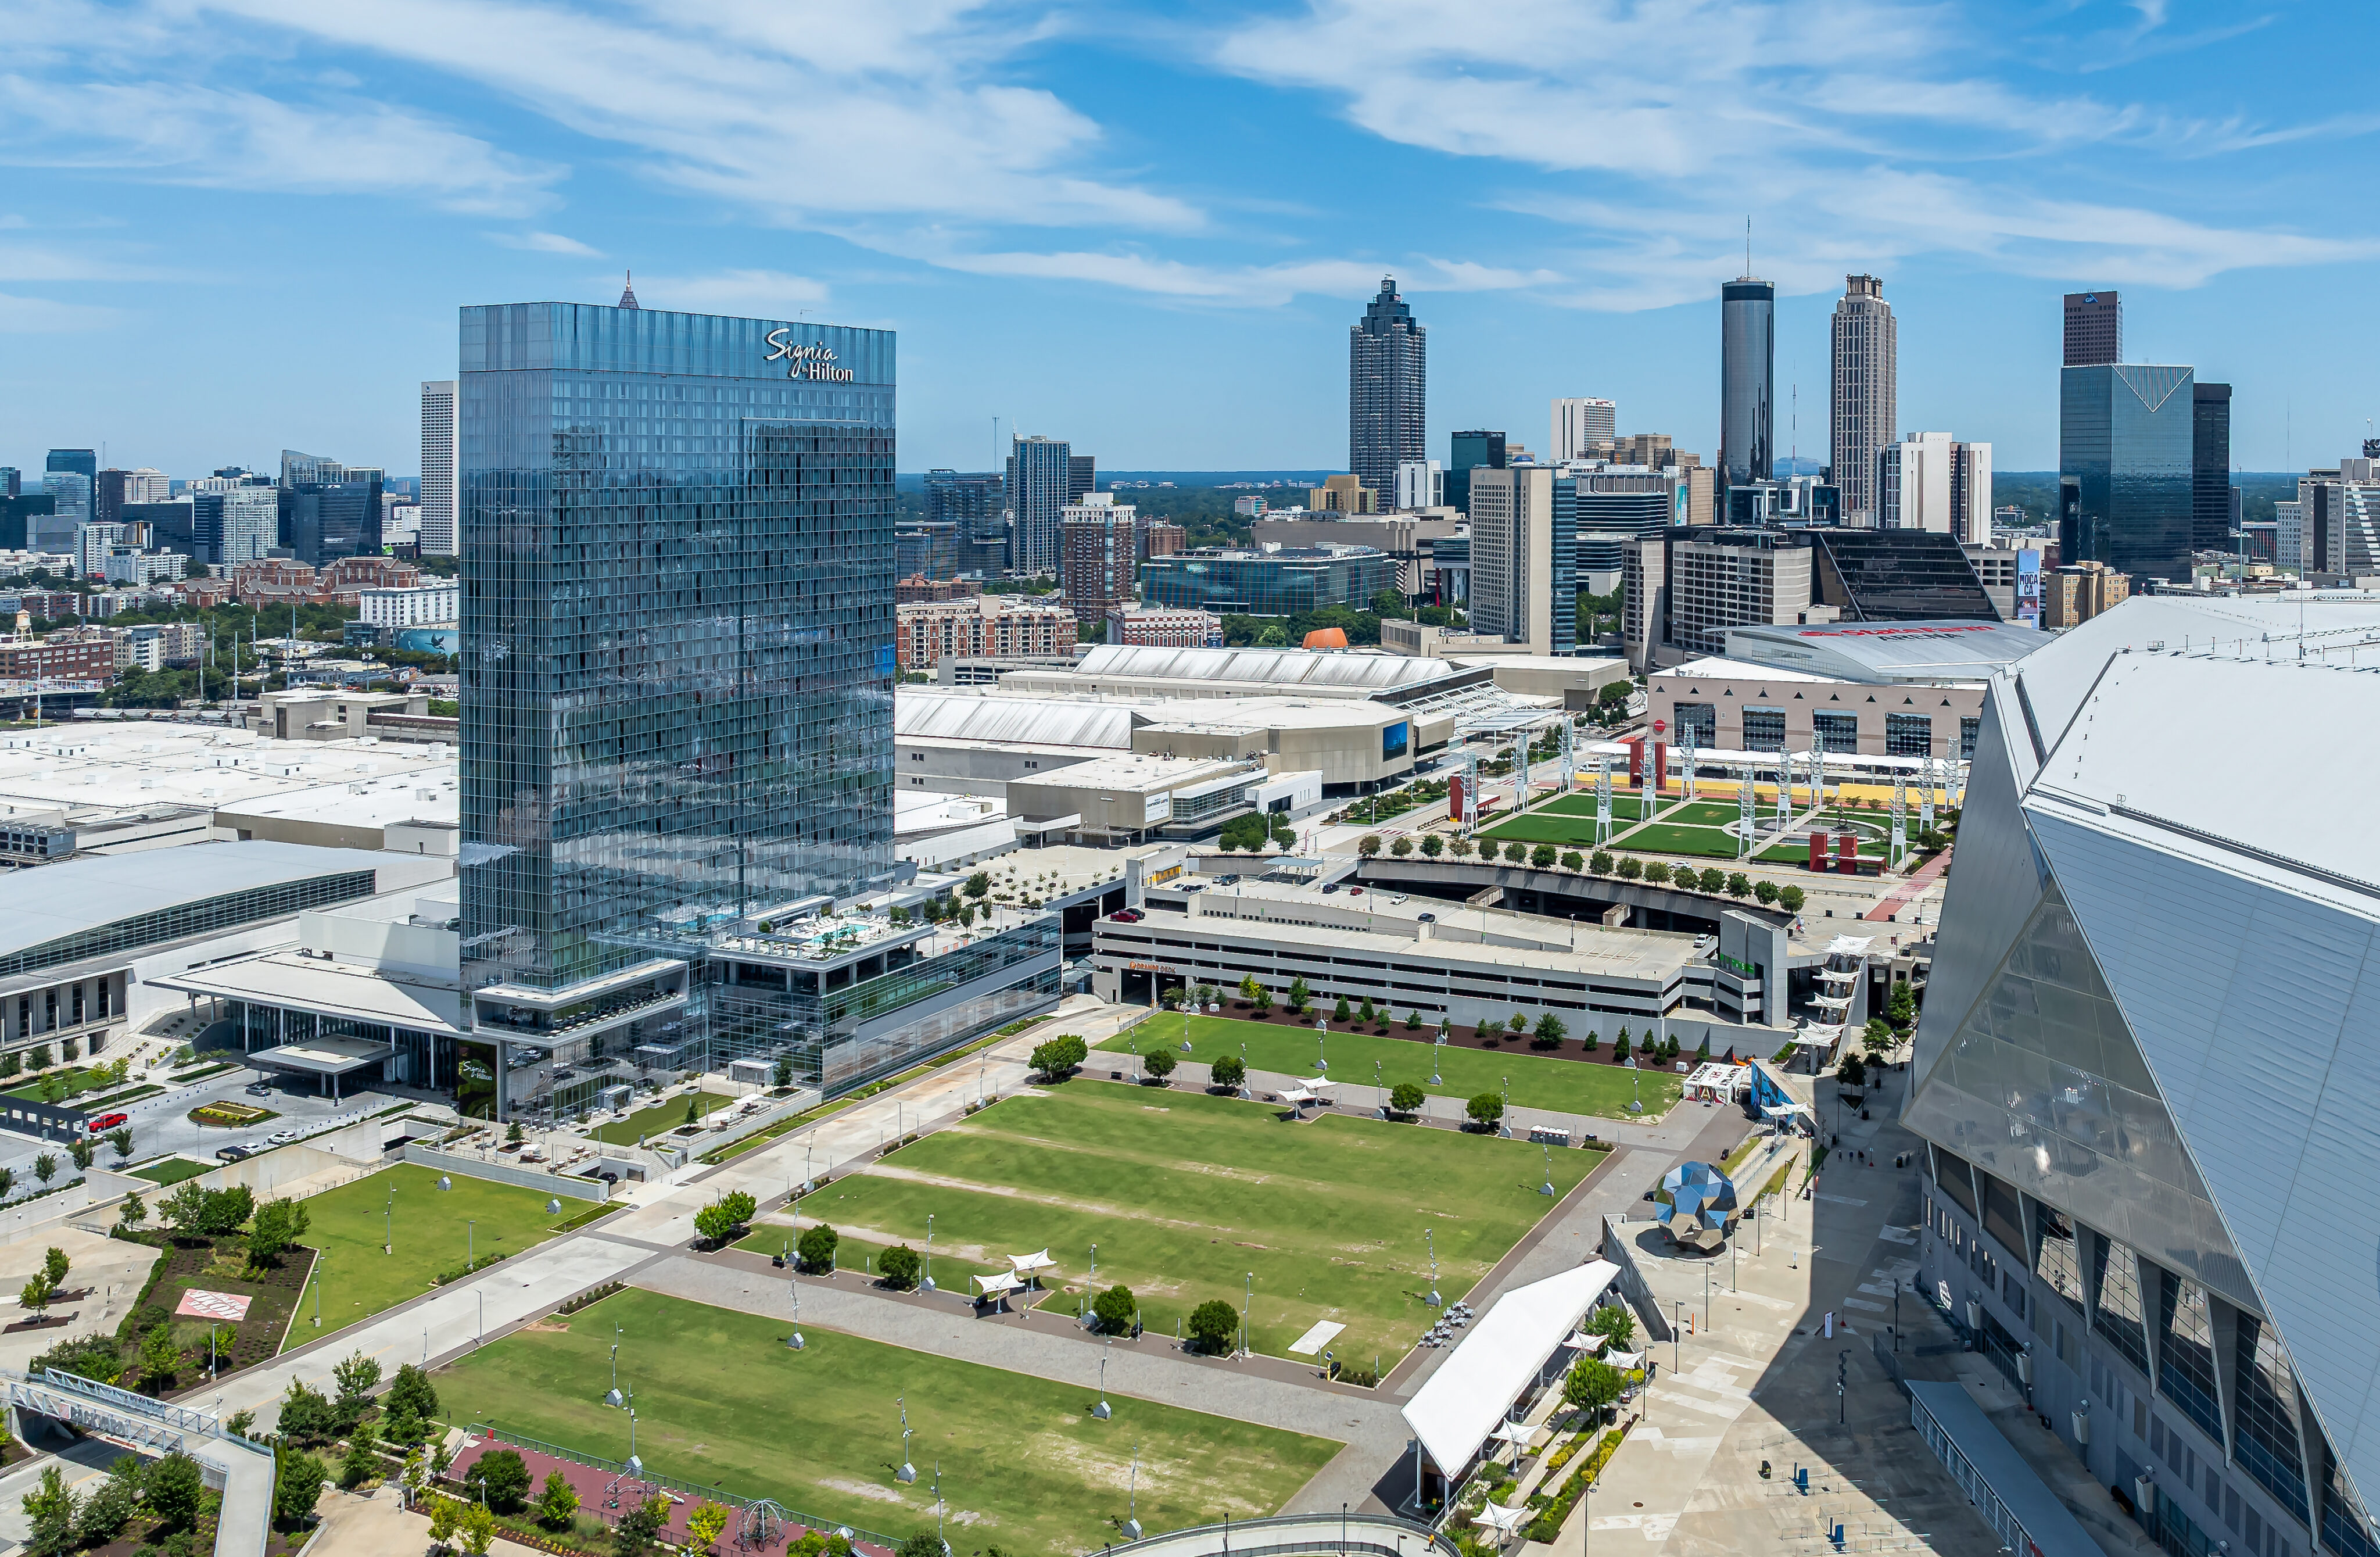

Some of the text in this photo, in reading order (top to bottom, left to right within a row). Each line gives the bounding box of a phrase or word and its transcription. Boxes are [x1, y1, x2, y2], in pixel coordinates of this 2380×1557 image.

[765, 328, 838, 378] Signia
[809, 362, 854, 382] Hilton
[2020, 574, 2038, 585] MOCA
[2024, 585, 2034, 595] GA
[1160, 965, 1176, 974] DECK
[463, 1061, 487, 1078] Signia
[186, 1290, 244, 1319] HOME
[187, 1300, 212, 1315] THE
[212, 1293, 248, 1311] DEPOT
